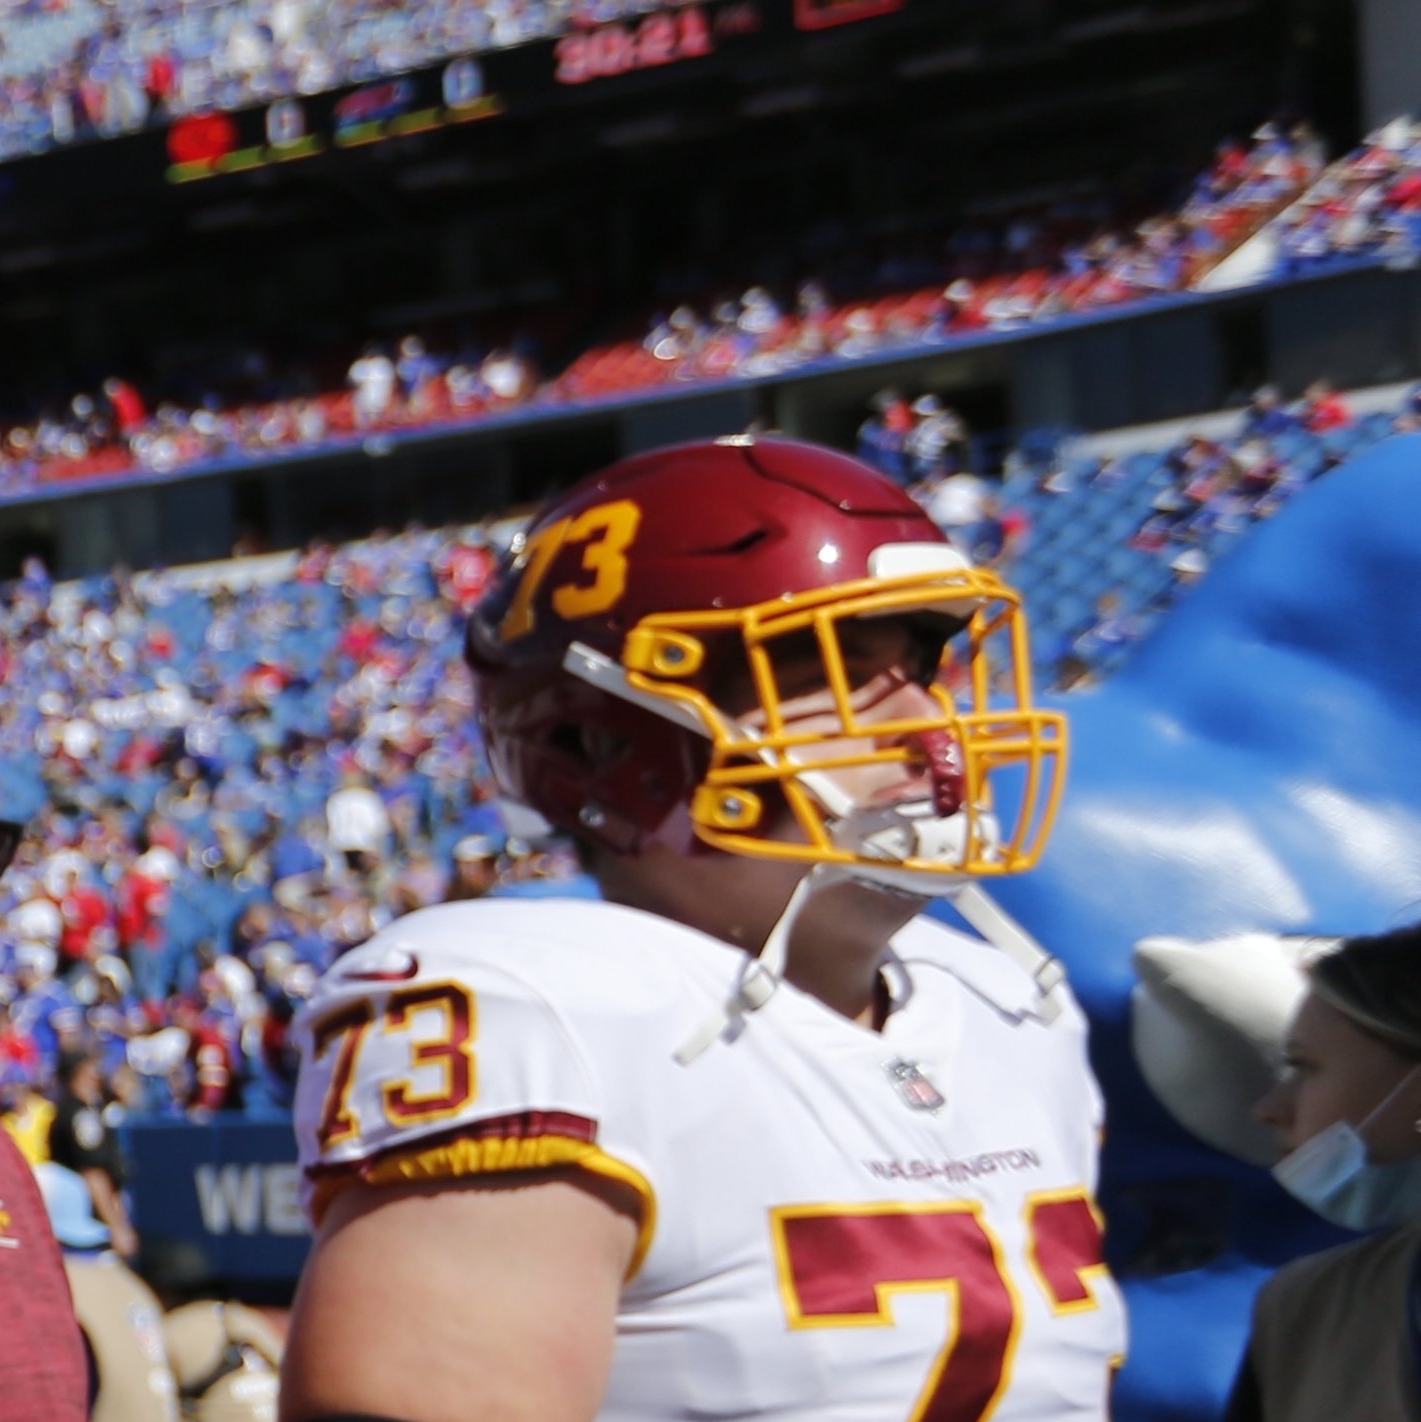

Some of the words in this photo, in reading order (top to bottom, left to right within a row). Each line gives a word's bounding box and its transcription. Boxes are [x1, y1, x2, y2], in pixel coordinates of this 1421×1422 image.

[500, 500, 643, 643] 73
[312, 978, 477, 1156] 73
[862, 1148, 1041, 1184] WASHINGTON
